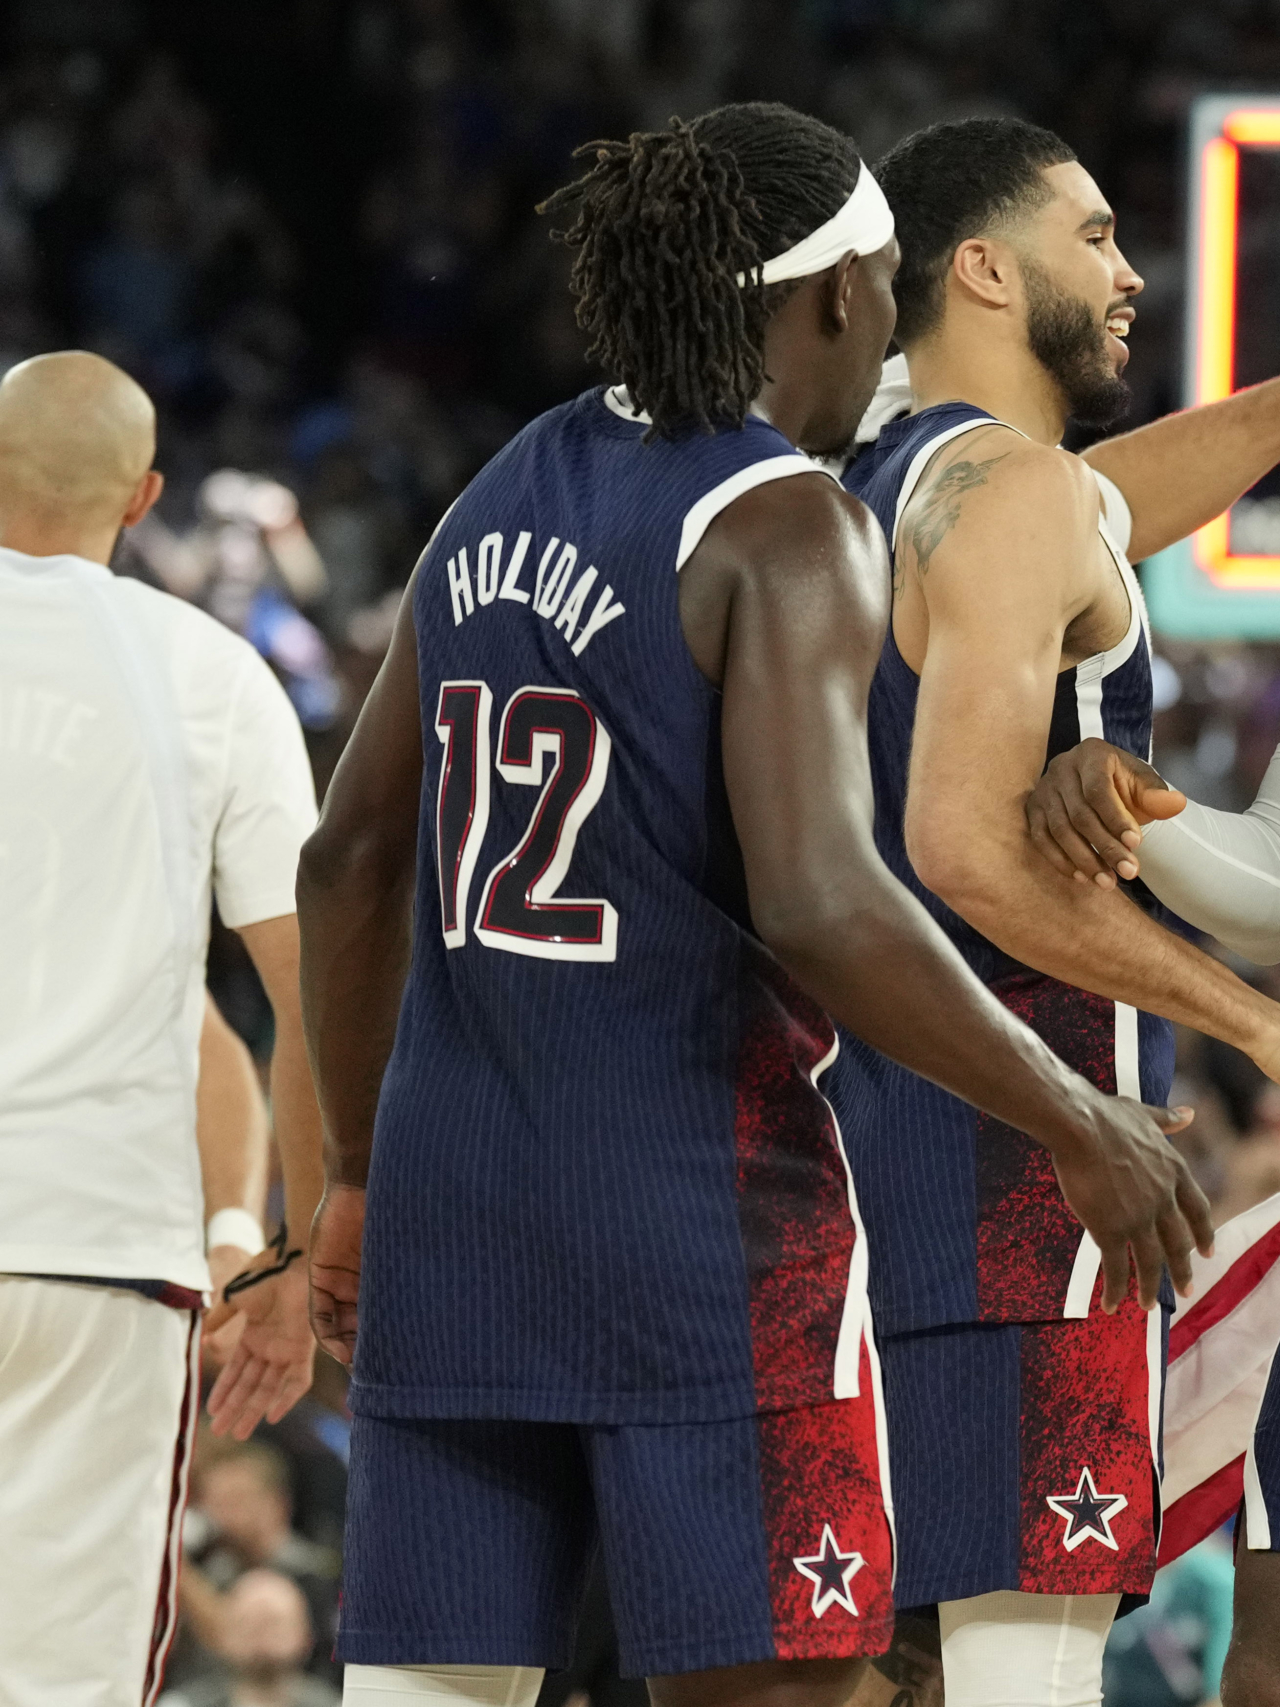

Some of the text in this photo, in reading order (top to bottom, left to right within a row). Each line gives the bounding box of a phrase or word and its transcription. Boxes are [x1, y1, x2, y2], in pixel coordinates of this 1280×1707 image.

[447, 531, 626, 657] HOLIDAY
[0, 685, 100, 769] ITE
[435, 680, 618, 963] 12
